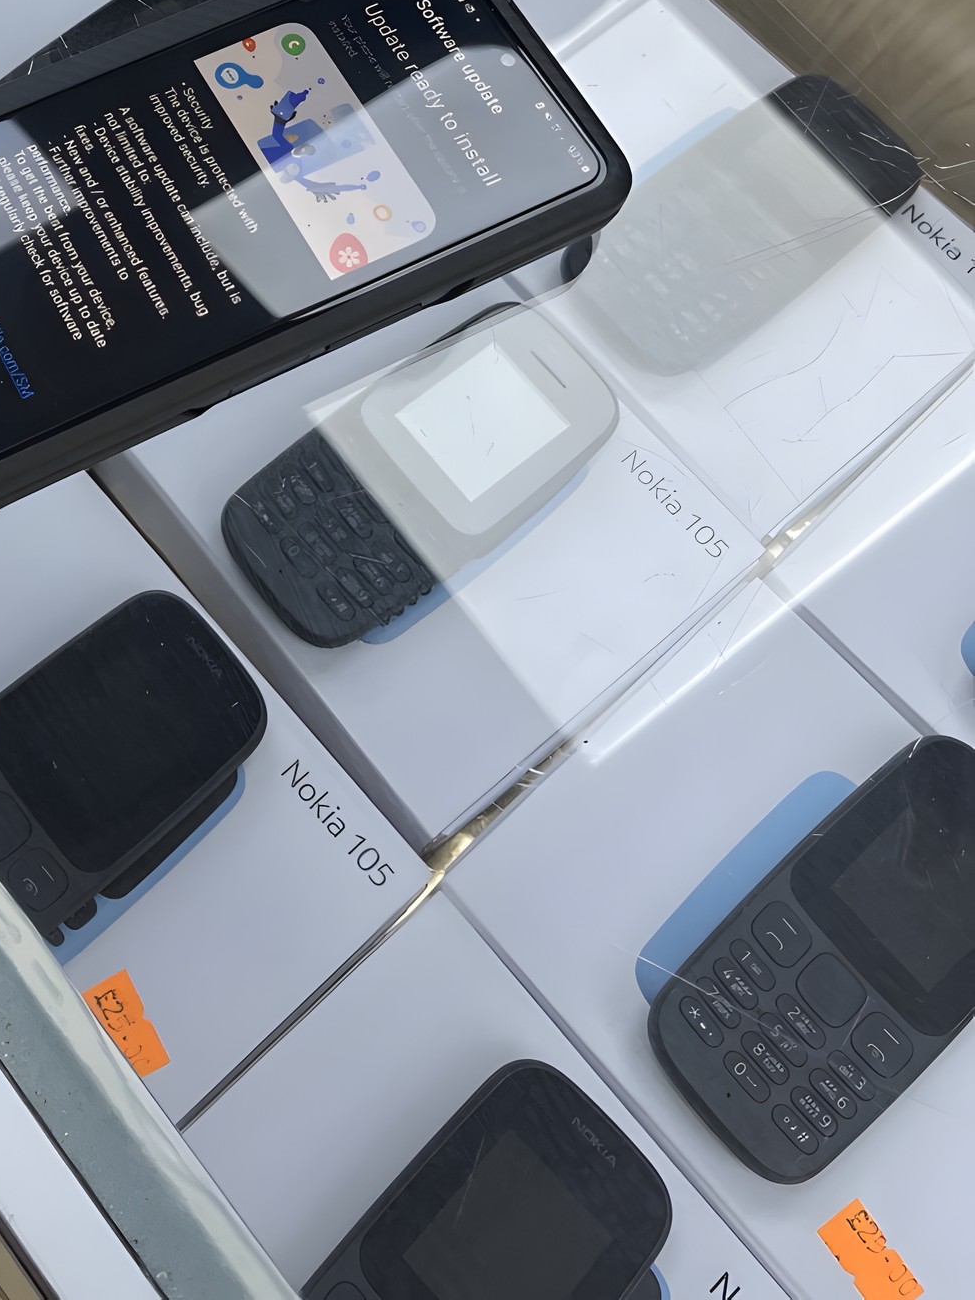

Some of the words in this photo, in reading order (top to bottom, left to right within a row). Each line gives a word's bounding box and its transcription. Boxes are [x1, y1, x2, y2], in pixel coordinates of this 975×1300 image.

[103, 112, 122, 132] not
[115, 130, 145, 169] limited
[148, 92, 186, 143] improved
[178, 143, 211, 189] security.
[164, 86, 181, 108] The
[176, 108, 203, 144] device
[364, 2, 411, 62] Update
[404, 63, 445, 109] ready
[439, 111, 458, 131] to
[453, 132, 503, 187] install
[461, 64, 503, 115] update
[198, 143, 210, 155] is
[202, 155, 245, 208] protected
[14, 149, 27, 166] To
[32, 184, 49, 205] the
[44, 204, 64, 232] best
[58, 231, 80, 261] from
[71, 260, 95, 287] your
[48, 145, 78, 187] Further
[71, 186, 122, 267] improvements
[116, 266, 129, 281] to
[64, 139, 84, 165] New
[78, 166, 99, 189] and
[96, 196, 110, 209] or
[104, 210, 144, 267] enhanced
[136, 266, 170, 320] features.
[93, 126, 121, 164] Device
[115, 164, 146, 207] stability
[189, 290, 209, 317] bug
[125, 116, 159, 163] software
[153, 163, 182, 203] update
[177, 203, 195, 226] can
[216, 269, 236, 292] but
[229, 291, 242, 305] is
[238, 207, 259, 234] with
[900, 203, 962, 261] Nokia
[20, 234, 46, 269] check
[39, 269, 55, 287] for
[49, 287, 83, 341] software
[30, 221, 54, 248] your
[47, 248, 74, 287] device
[68, 287, 83, 305] up
[78, 304, 91, 319] to
[86, 319, 107, 349] date
[620, 449, 682, 516] Nokia
[685, 513, 730, 558] 105
[279, 757, 348, 839] Nokia
[347, 833, 396, 889] 105
[571, 1116, 616, 1168] NOKIA
